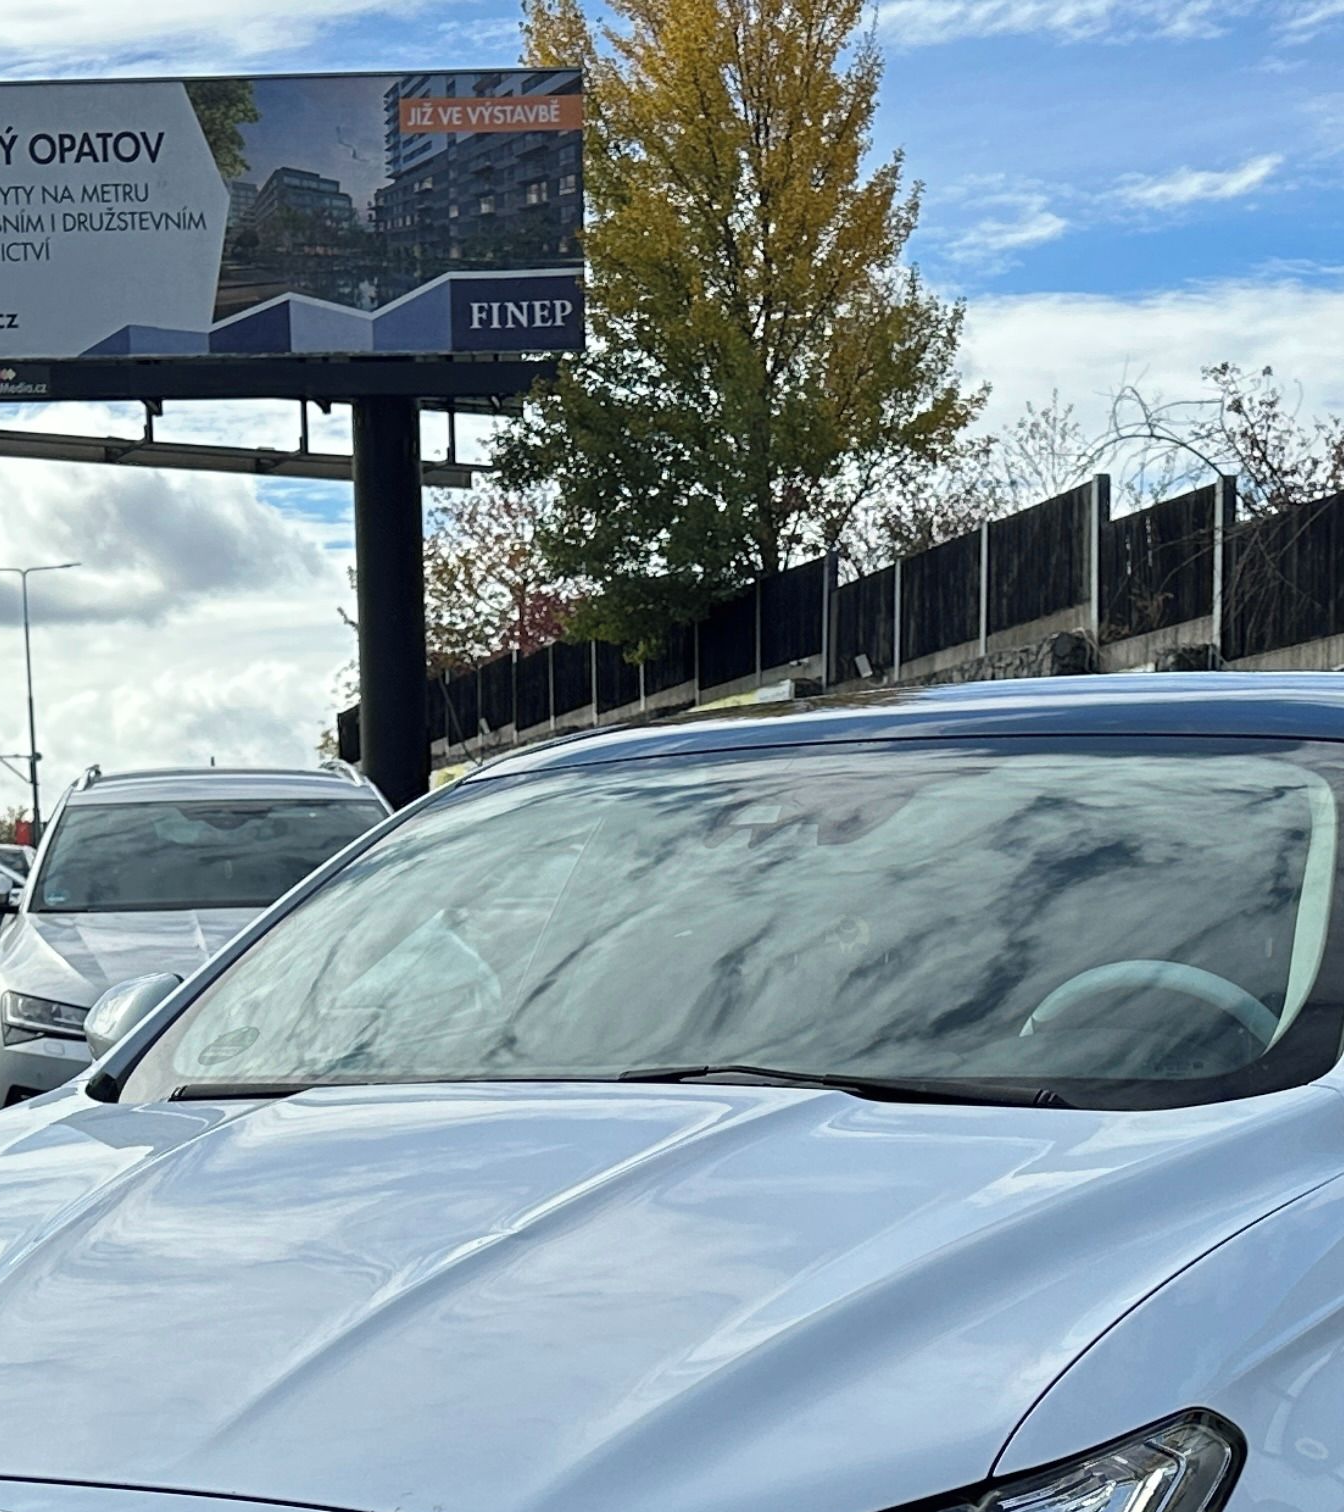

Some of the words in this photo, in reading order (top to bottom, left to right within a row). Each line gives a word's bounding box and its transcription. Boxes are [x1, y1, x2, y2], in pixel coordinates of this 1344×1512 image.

[408, 103, 433, 126] JIŽ
[438, 106, 462, 126] VE
[466, 100, 560, 125] VÝSTAVBĚ
[29, 131, 165, 165] OPATOV
[42, 185, 75, 204] NA
[81, 183, 149, 203] METRU
[51, 214, 56, 233] I
[63, 206, 207, 232] DRUŽSTEVNÍM
[469, 300, 573, 329] FINEP
